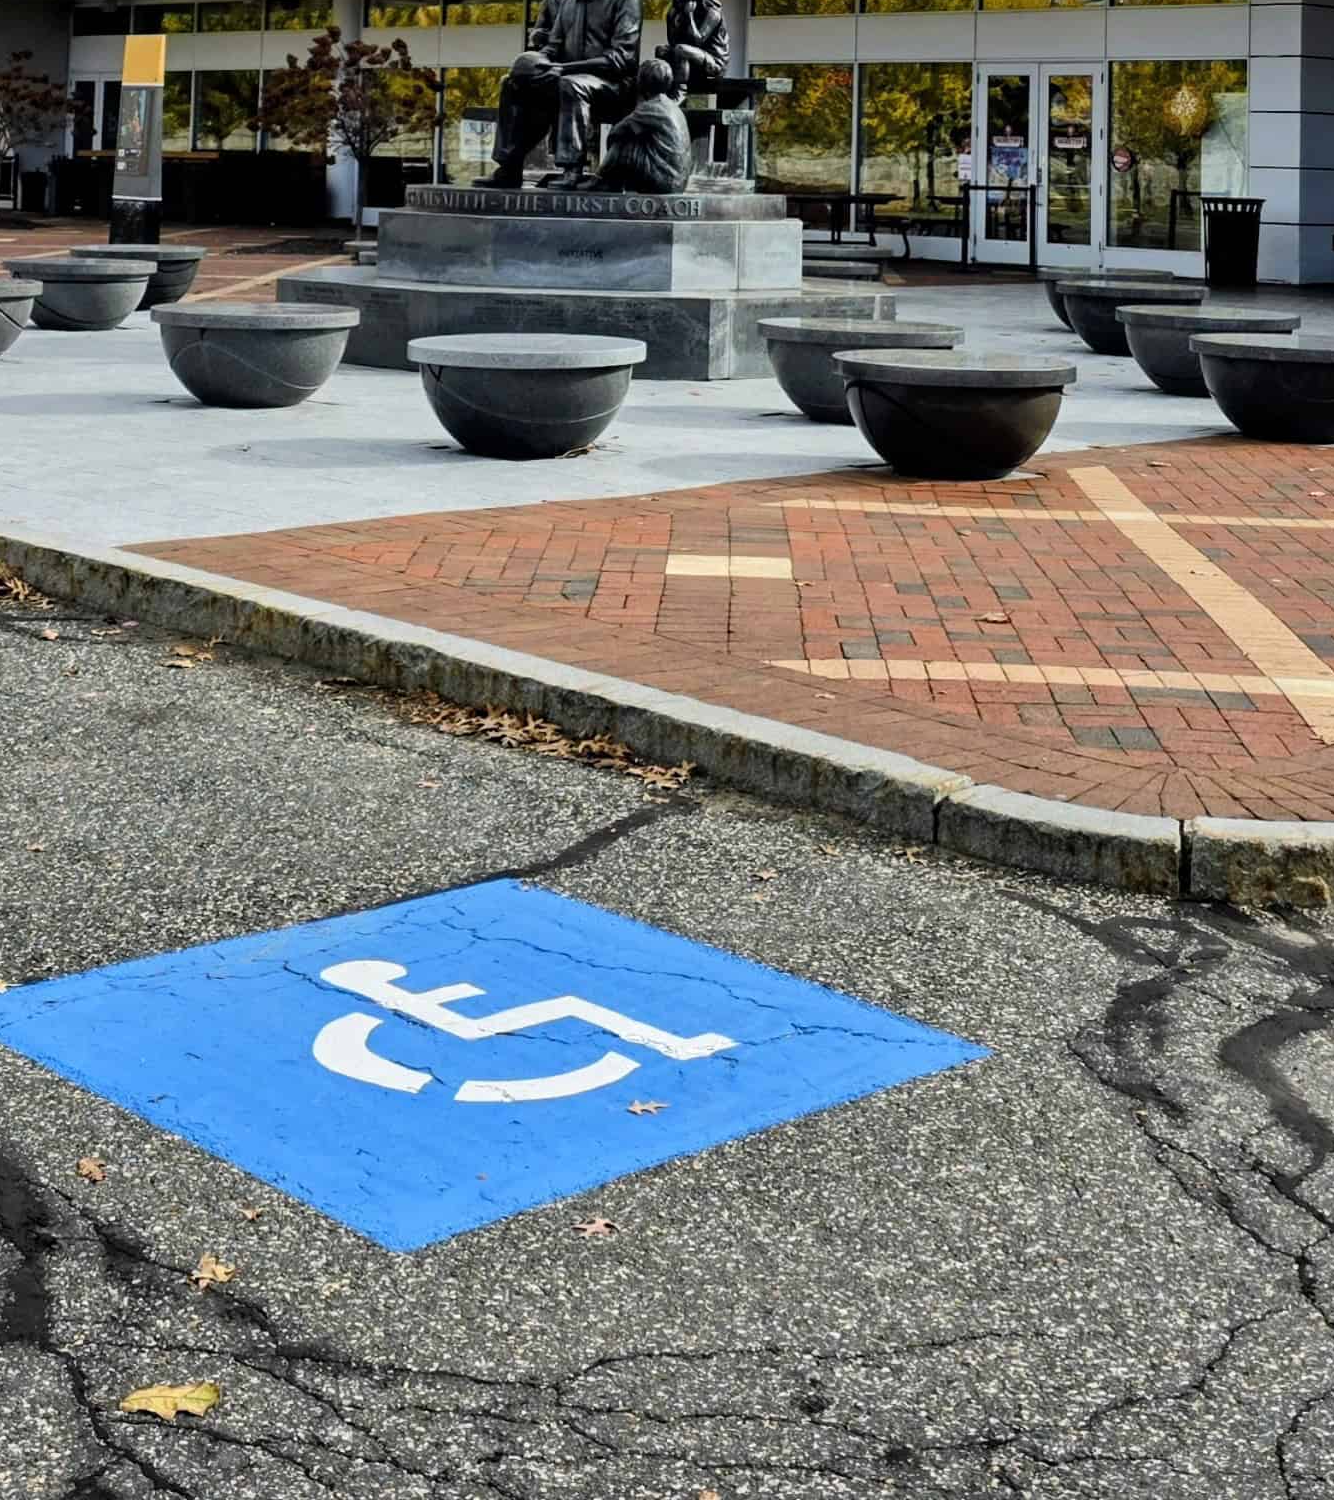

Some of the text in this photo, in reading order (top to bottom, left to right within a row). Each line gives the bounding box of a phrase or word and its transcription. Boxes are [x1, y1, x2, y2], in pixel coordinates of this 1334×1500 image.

[500, 194, 544, 212] THE
[552, 195, 619, 213] FIRST
[625, 197, 702, 217] COACH
